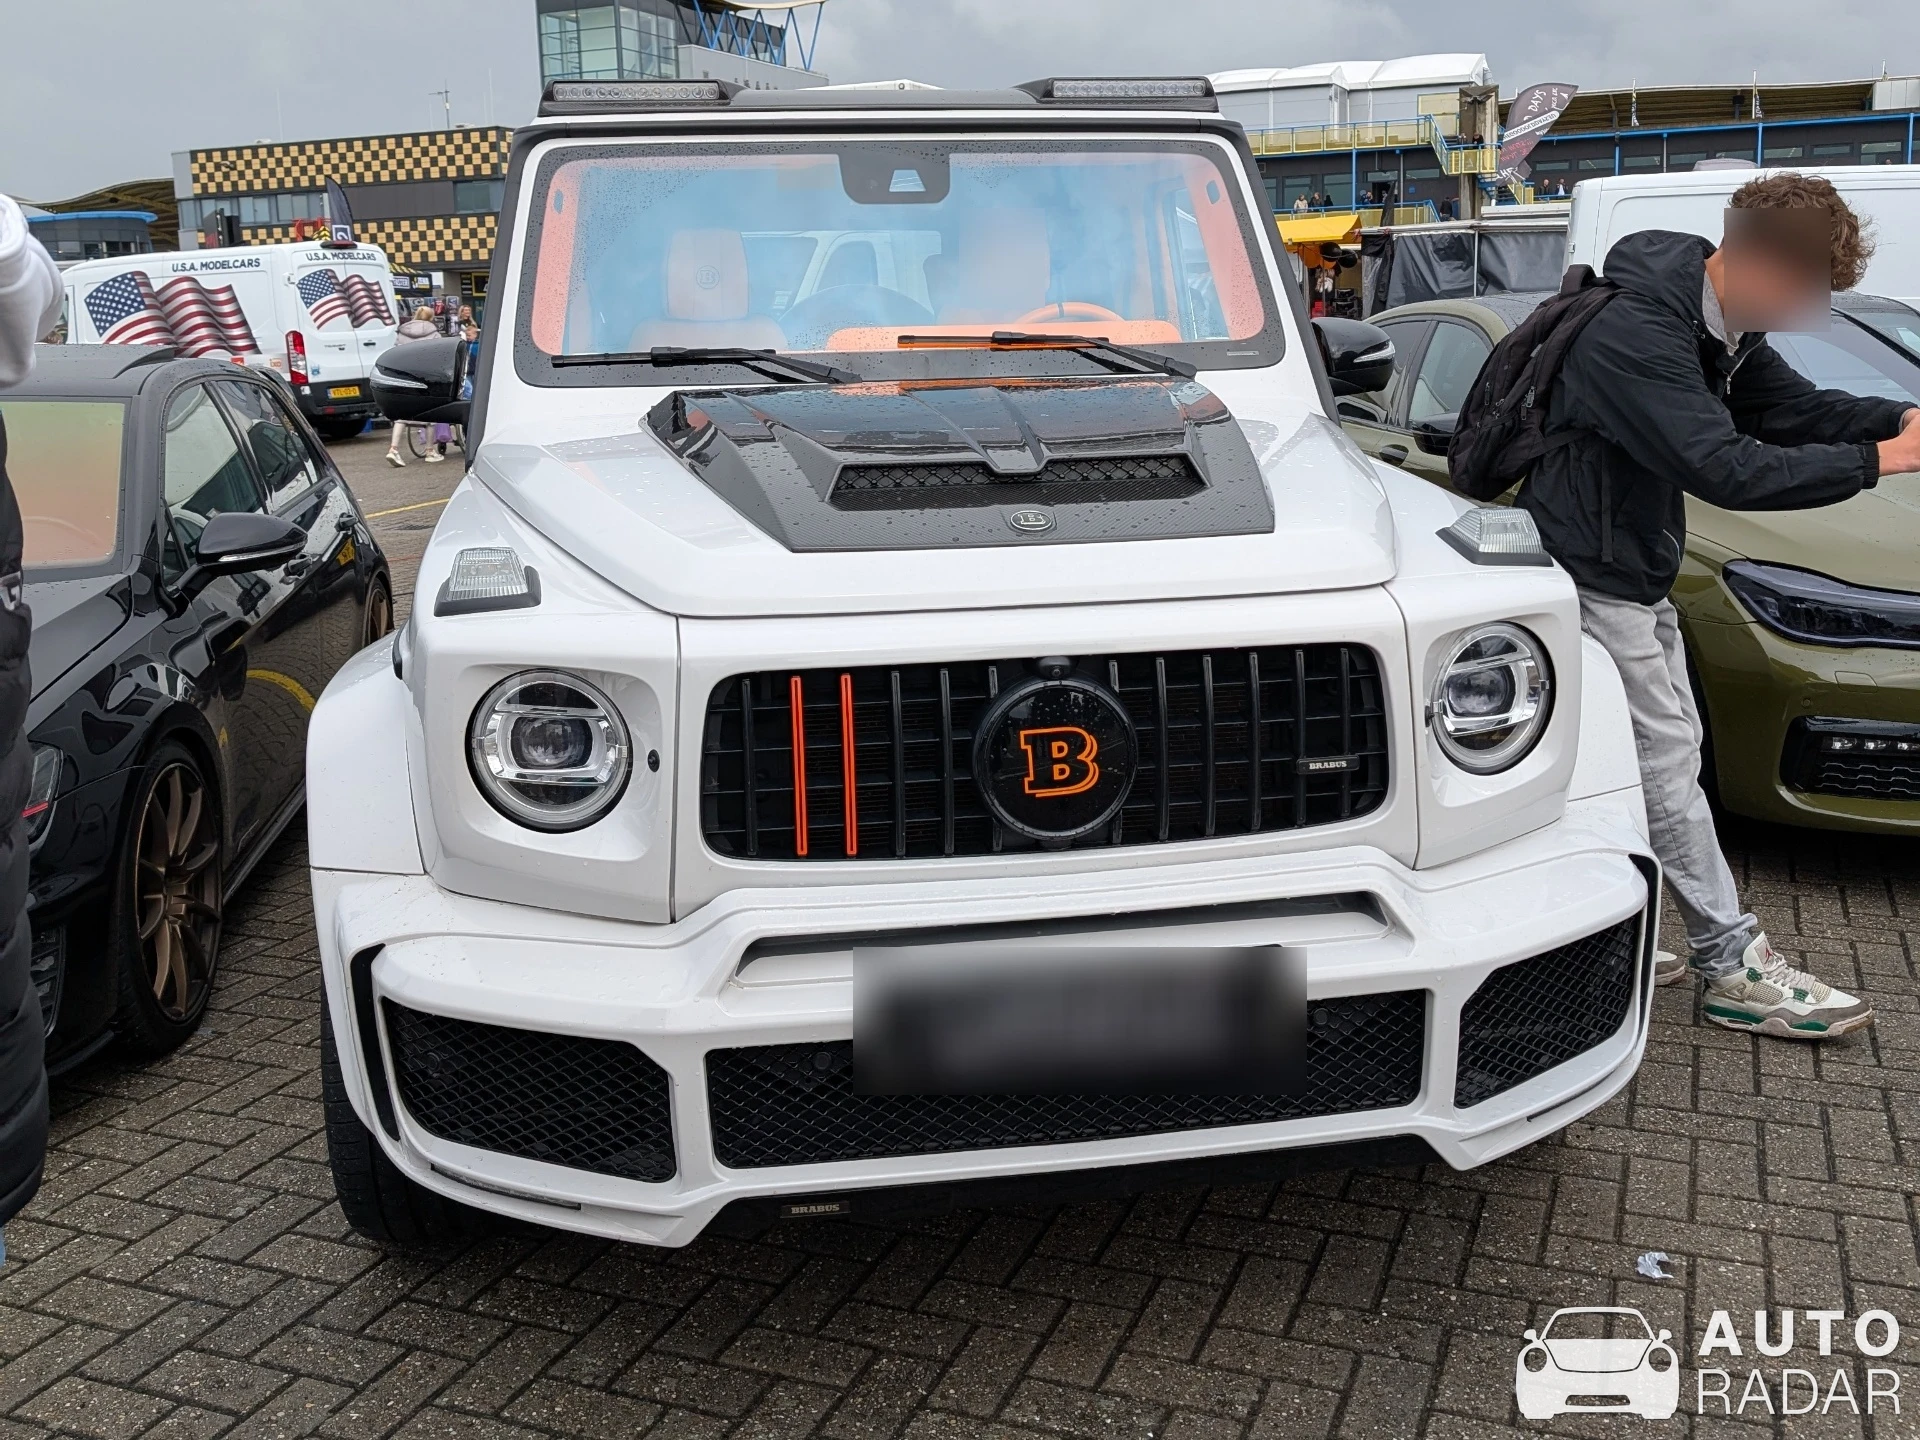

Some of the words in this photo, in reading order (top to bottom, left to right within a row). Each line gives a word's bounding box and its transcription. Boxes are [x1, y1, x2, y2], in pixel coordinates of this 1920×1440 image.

[1528, 89, 1547, 112] DAYS
[305, 252, 331, 261] U.S.A.
[331, 252, 376, 261] MODELCARS
[172, 262, 198, 273] U.S.A.
[200, 258, 261, 271] MODELCARS
[1020, 727, 1099, 797] B
[1309, 761, 1347, 770] BRABUS
[791, 1203, 840, 1214] BRABUS
